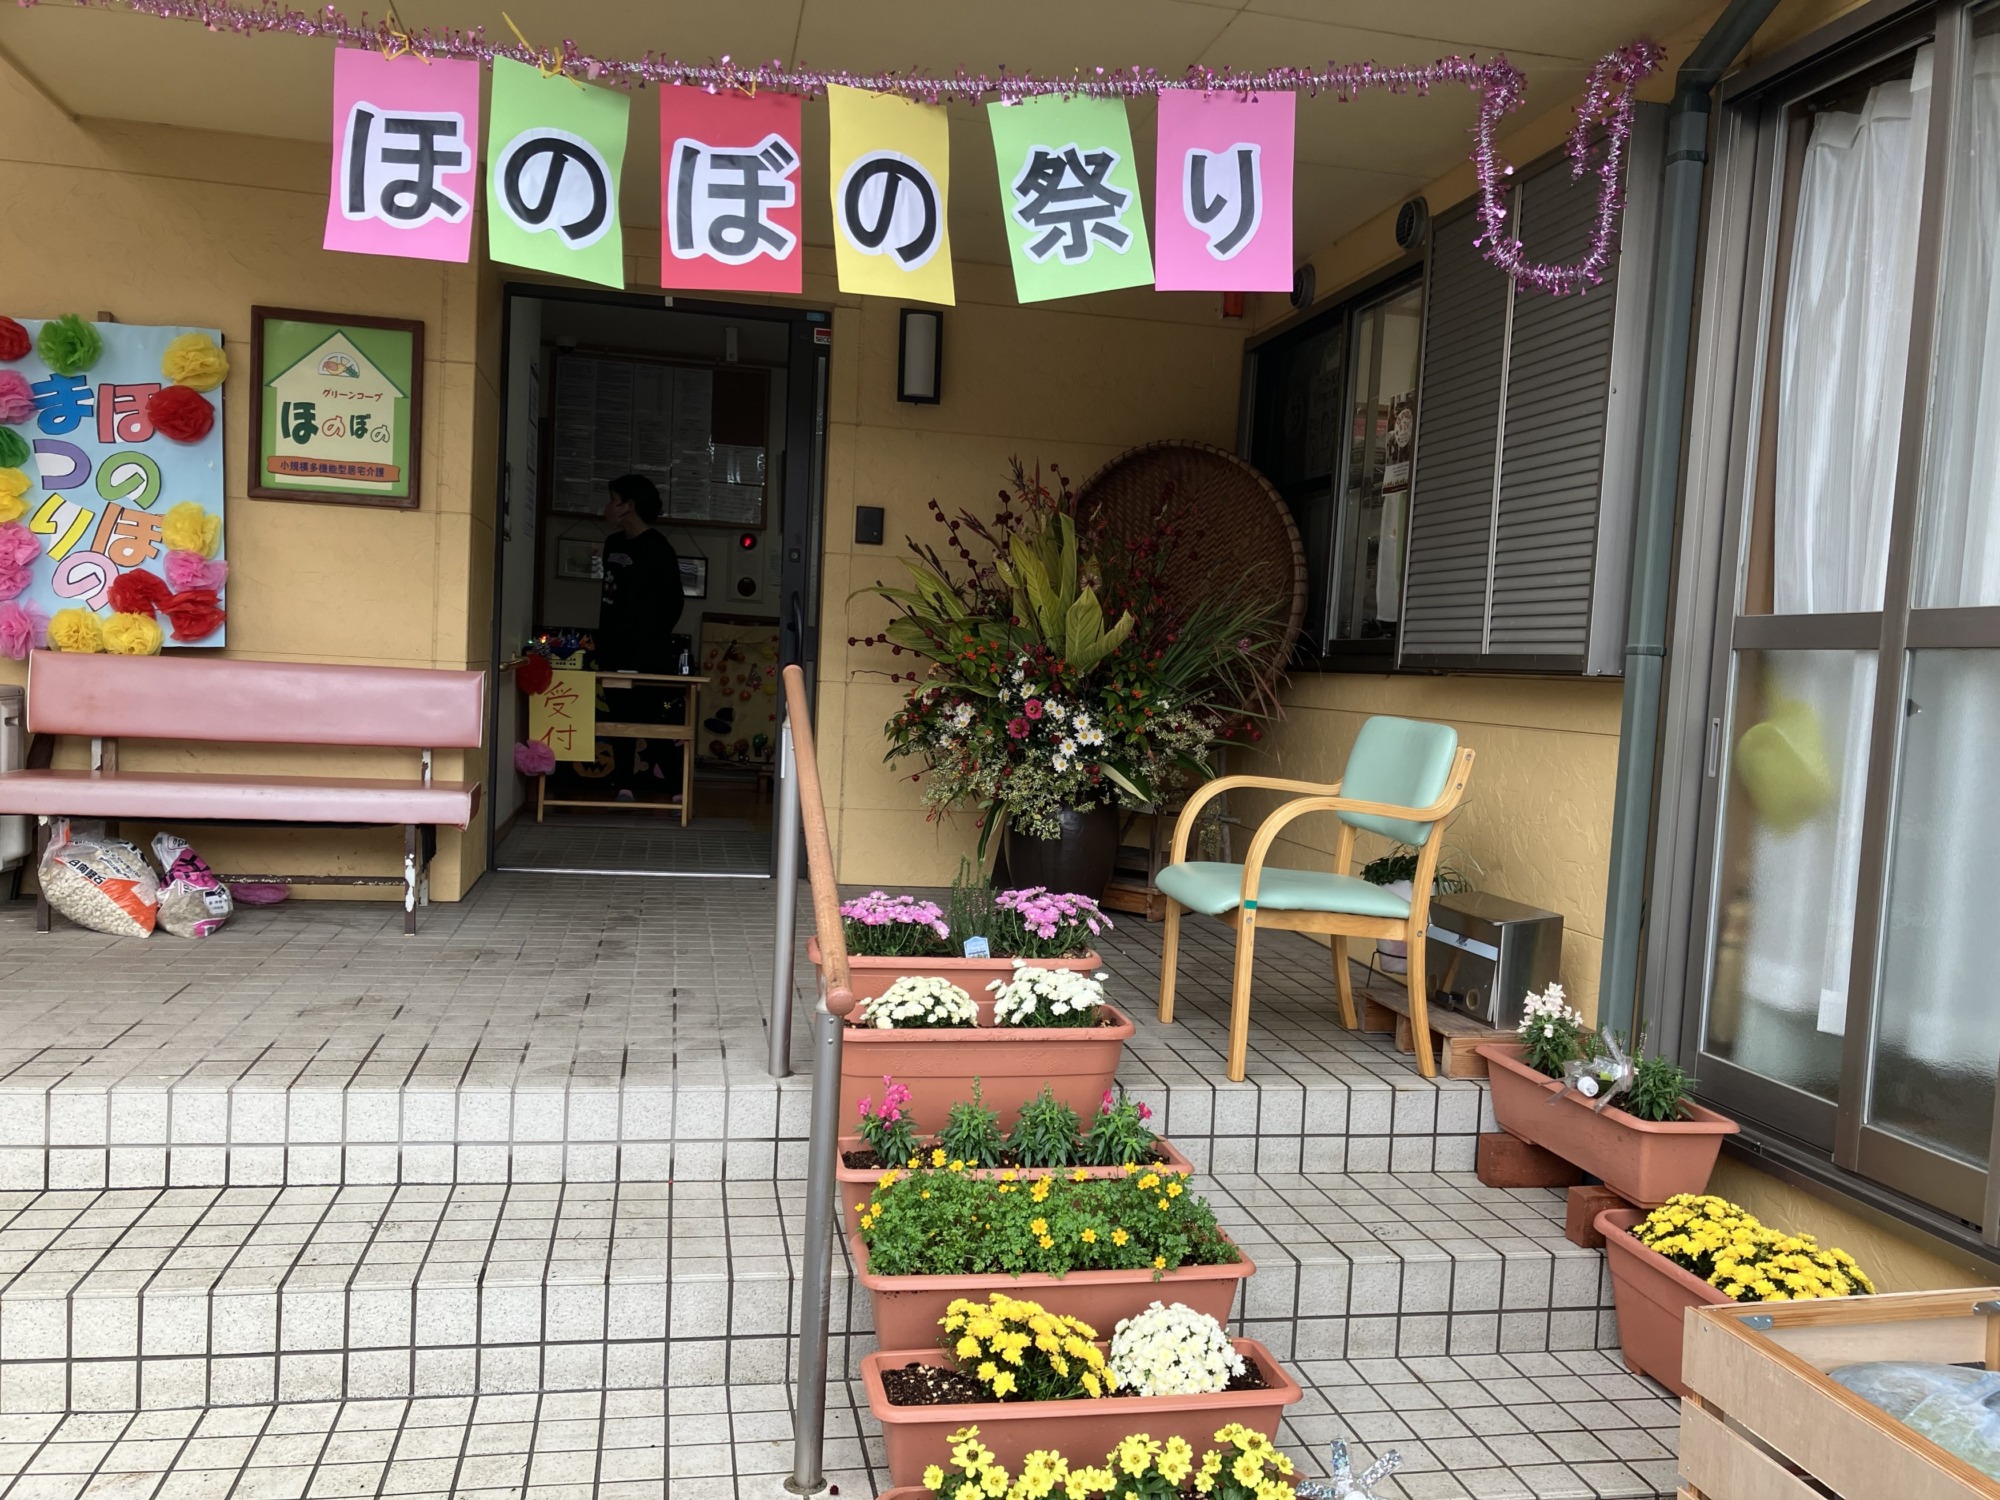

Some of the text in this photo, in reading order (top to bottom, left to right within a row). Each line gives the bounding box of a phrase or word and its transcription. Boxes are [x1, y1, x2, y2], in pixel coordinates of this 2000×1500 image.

[347, 108, 1255, 263] ほのぼの祭り
[281, 401, 390, 445] ほのぼの
[280, 460, 385, 478] 小規模多機能型居宅介護
[541, 681, 579, 751] 受付
